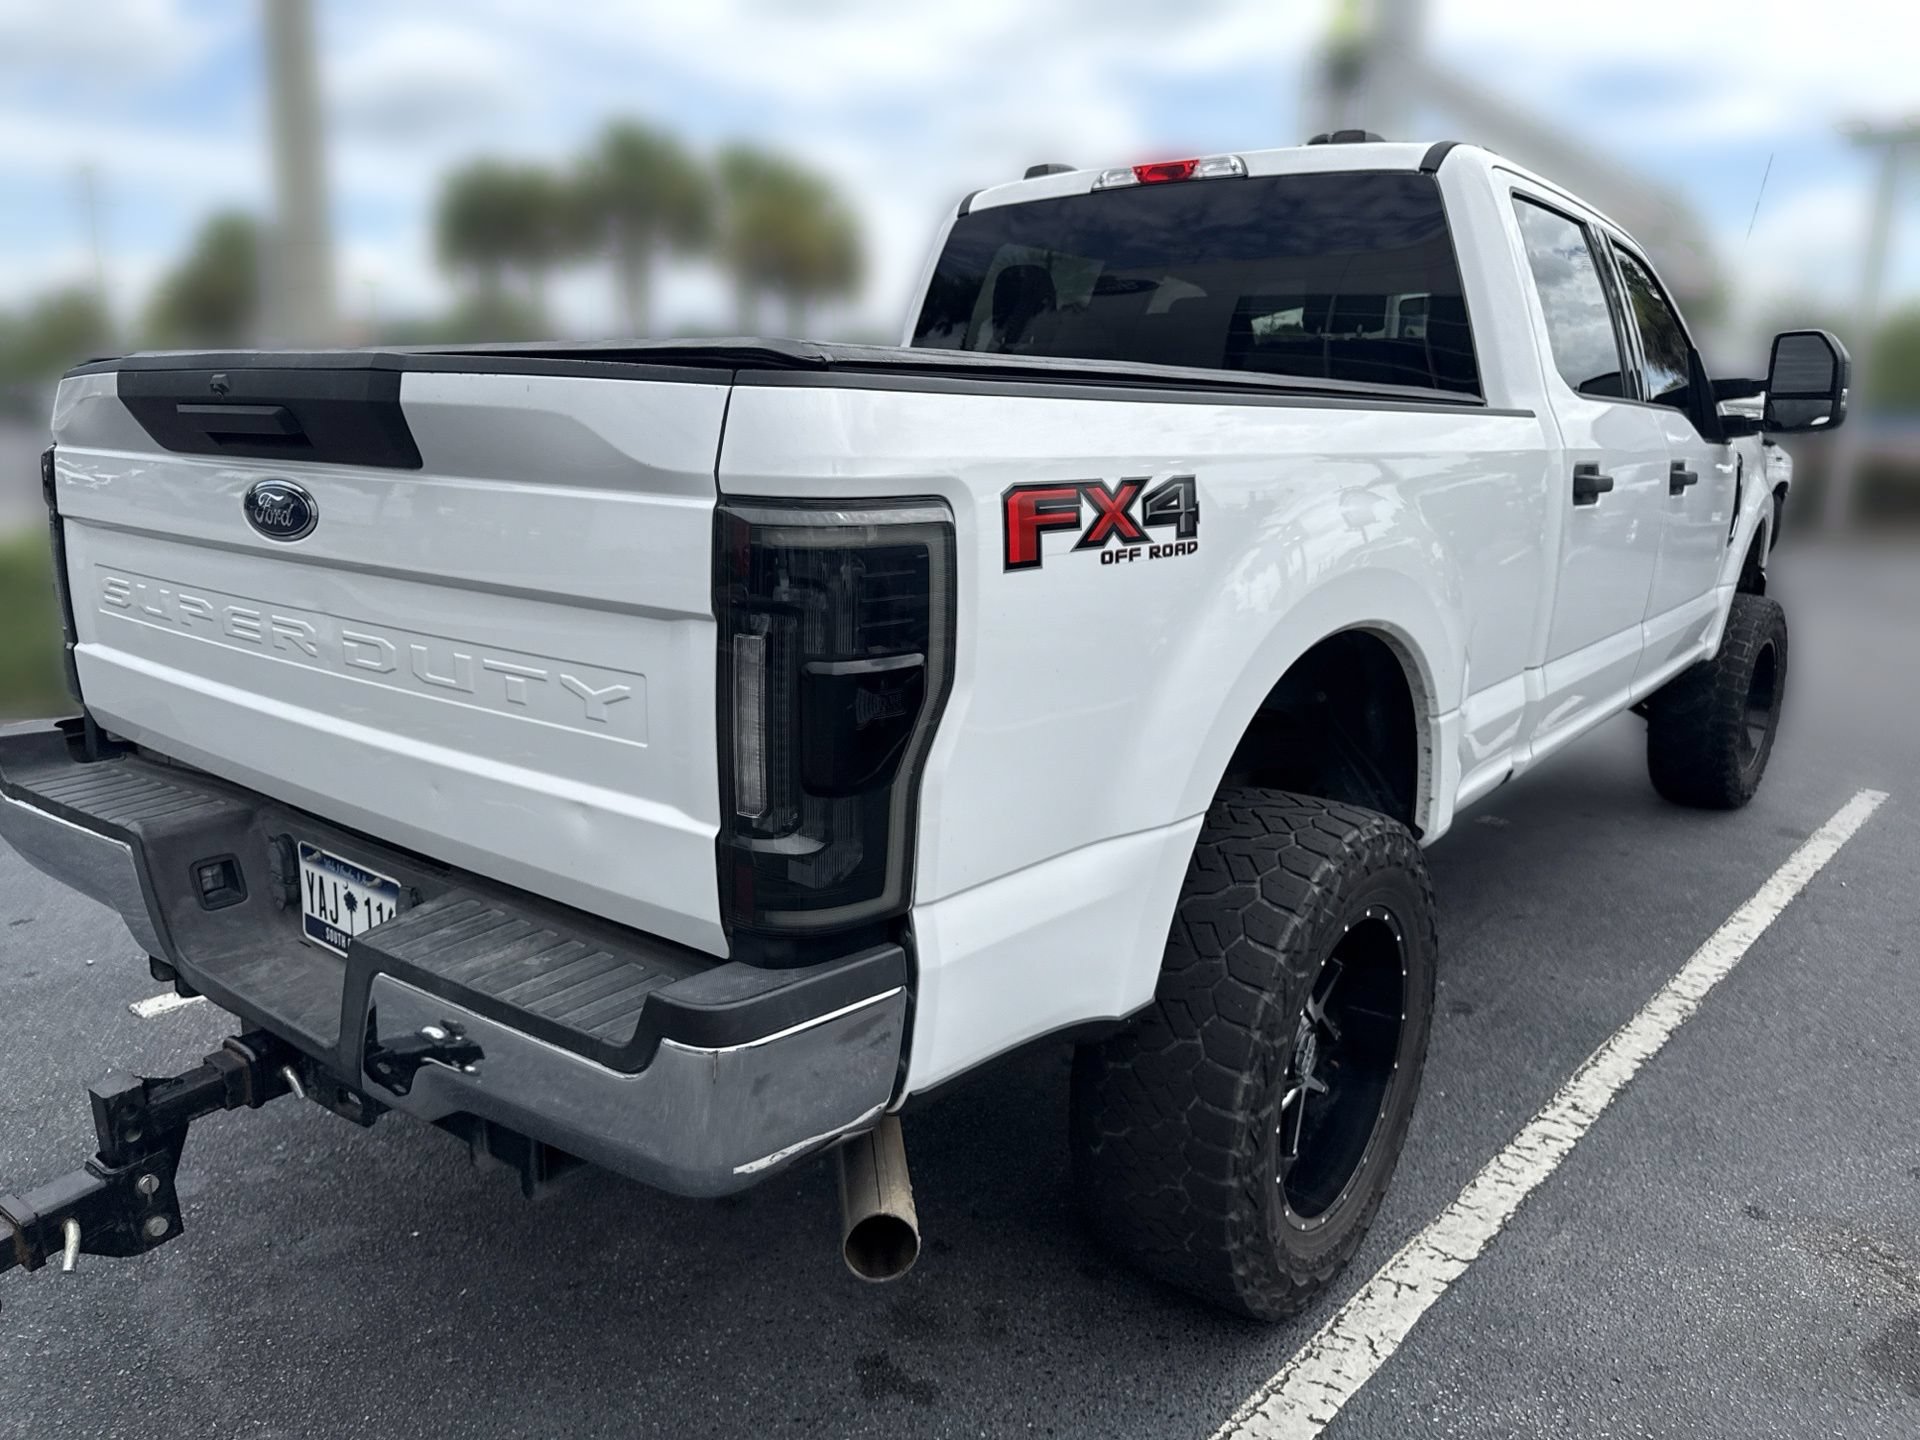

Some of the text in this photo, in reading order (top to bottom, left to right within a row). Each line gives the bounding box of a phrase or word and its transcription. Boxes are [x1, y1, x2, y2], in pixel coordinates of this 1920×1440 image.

[254, 492, 294, 527] Ford
[1000, 473, 1200, 573] FX4
[1100, 541, 1199, 565] OFF ROAD
[100, 575, 632, 724] SUPER DUTY
[305, 869, 339, 925] YAJ
[364, 896, 395, 929] 11
[325, 926, 347, 949] SOUTH
